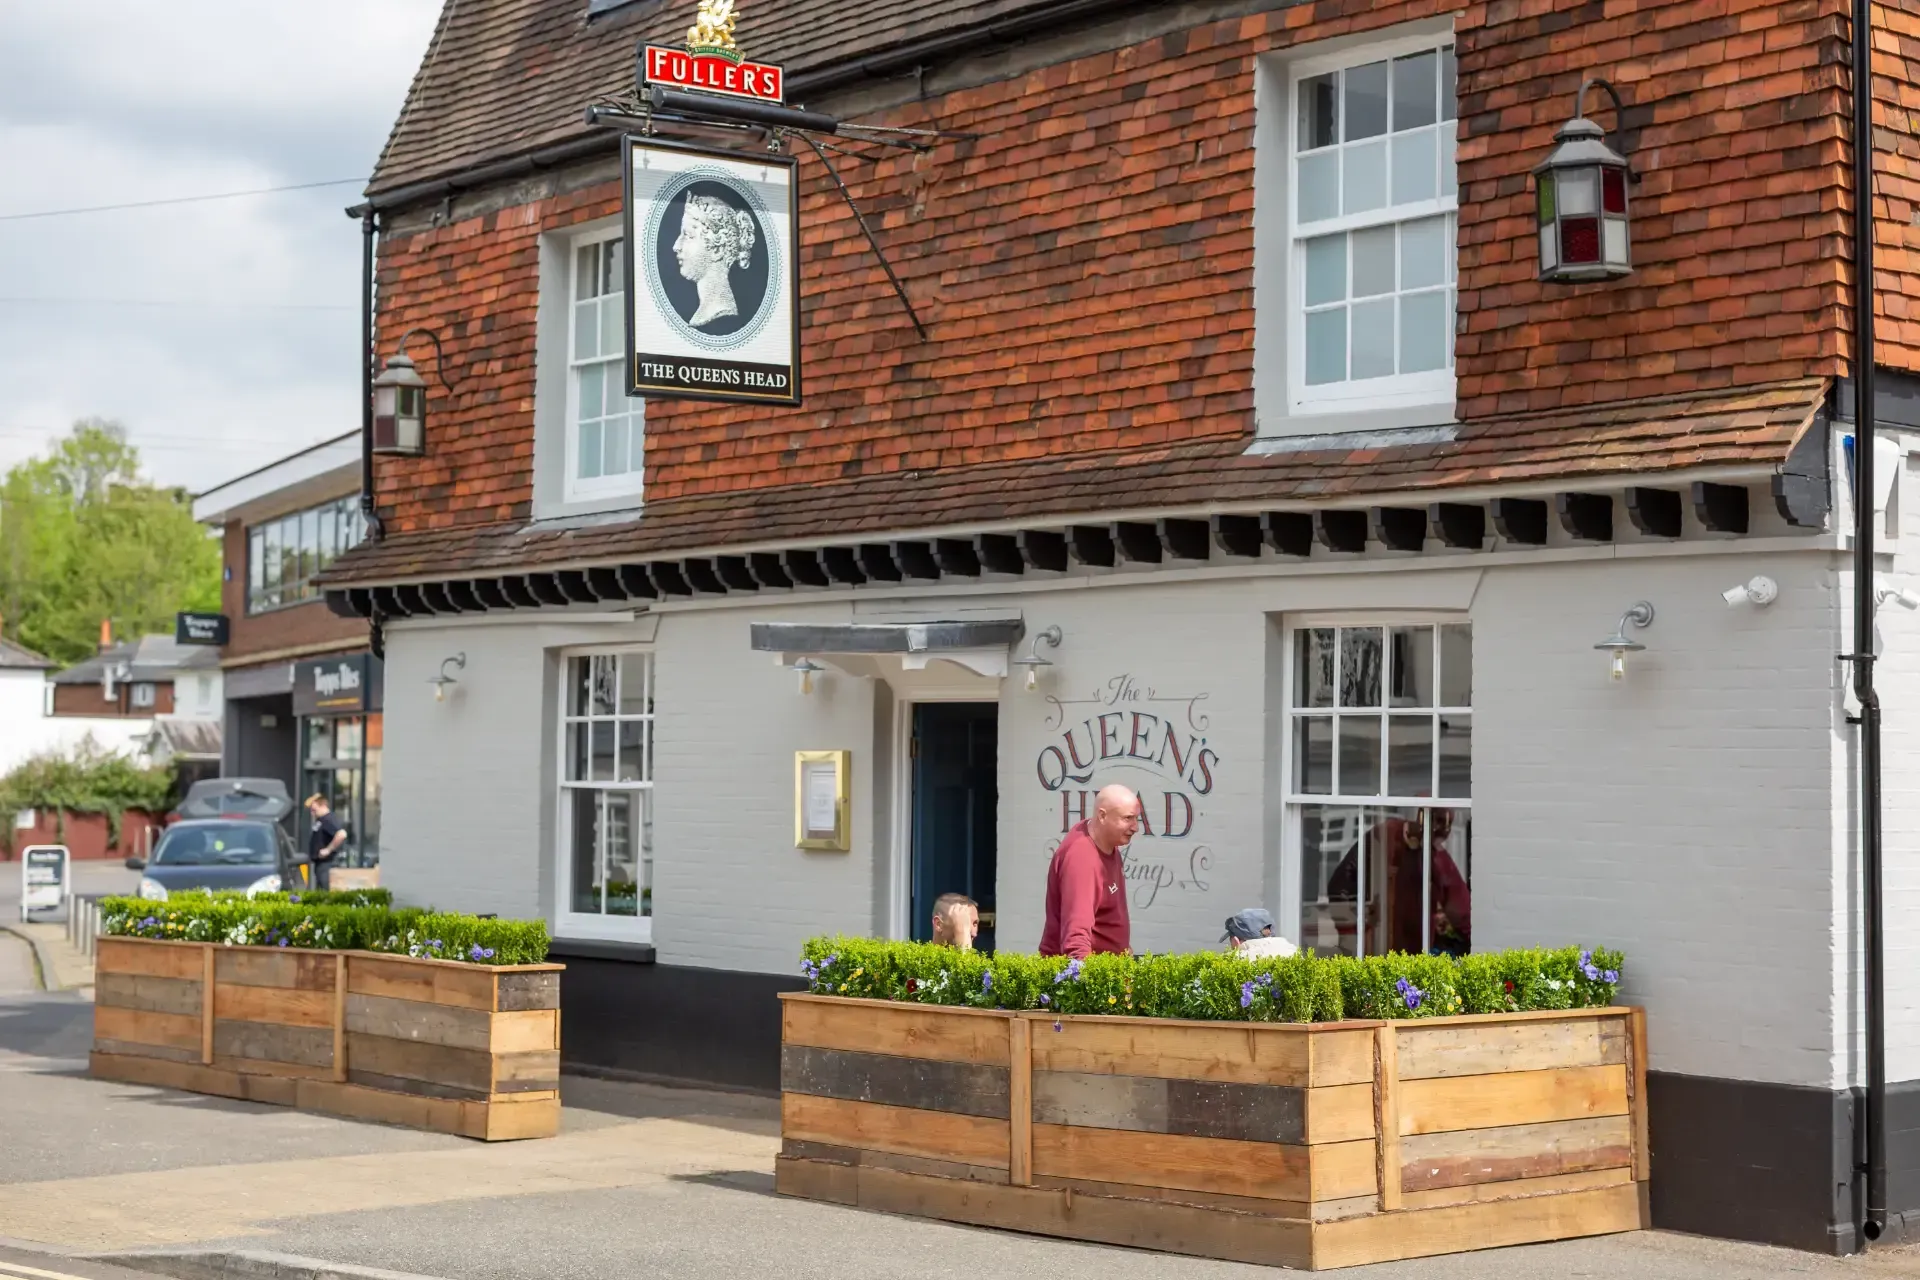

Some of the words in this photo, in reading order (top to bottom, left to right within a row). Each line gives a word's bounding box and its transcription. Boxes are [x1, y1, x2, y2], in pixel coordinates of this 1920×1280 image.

[653, 49, 775, 95] FULLER'S
[641, 362, 675, 379] THE
[678, 365, 741, 384] QUEEN'S
[744, 371, 788, 388] HEAD
[1103, 673, 1141, 706] The
[1037, 710, 1220, 796] QUEEN'S
[1060, 789, 1194, 838] HAD
